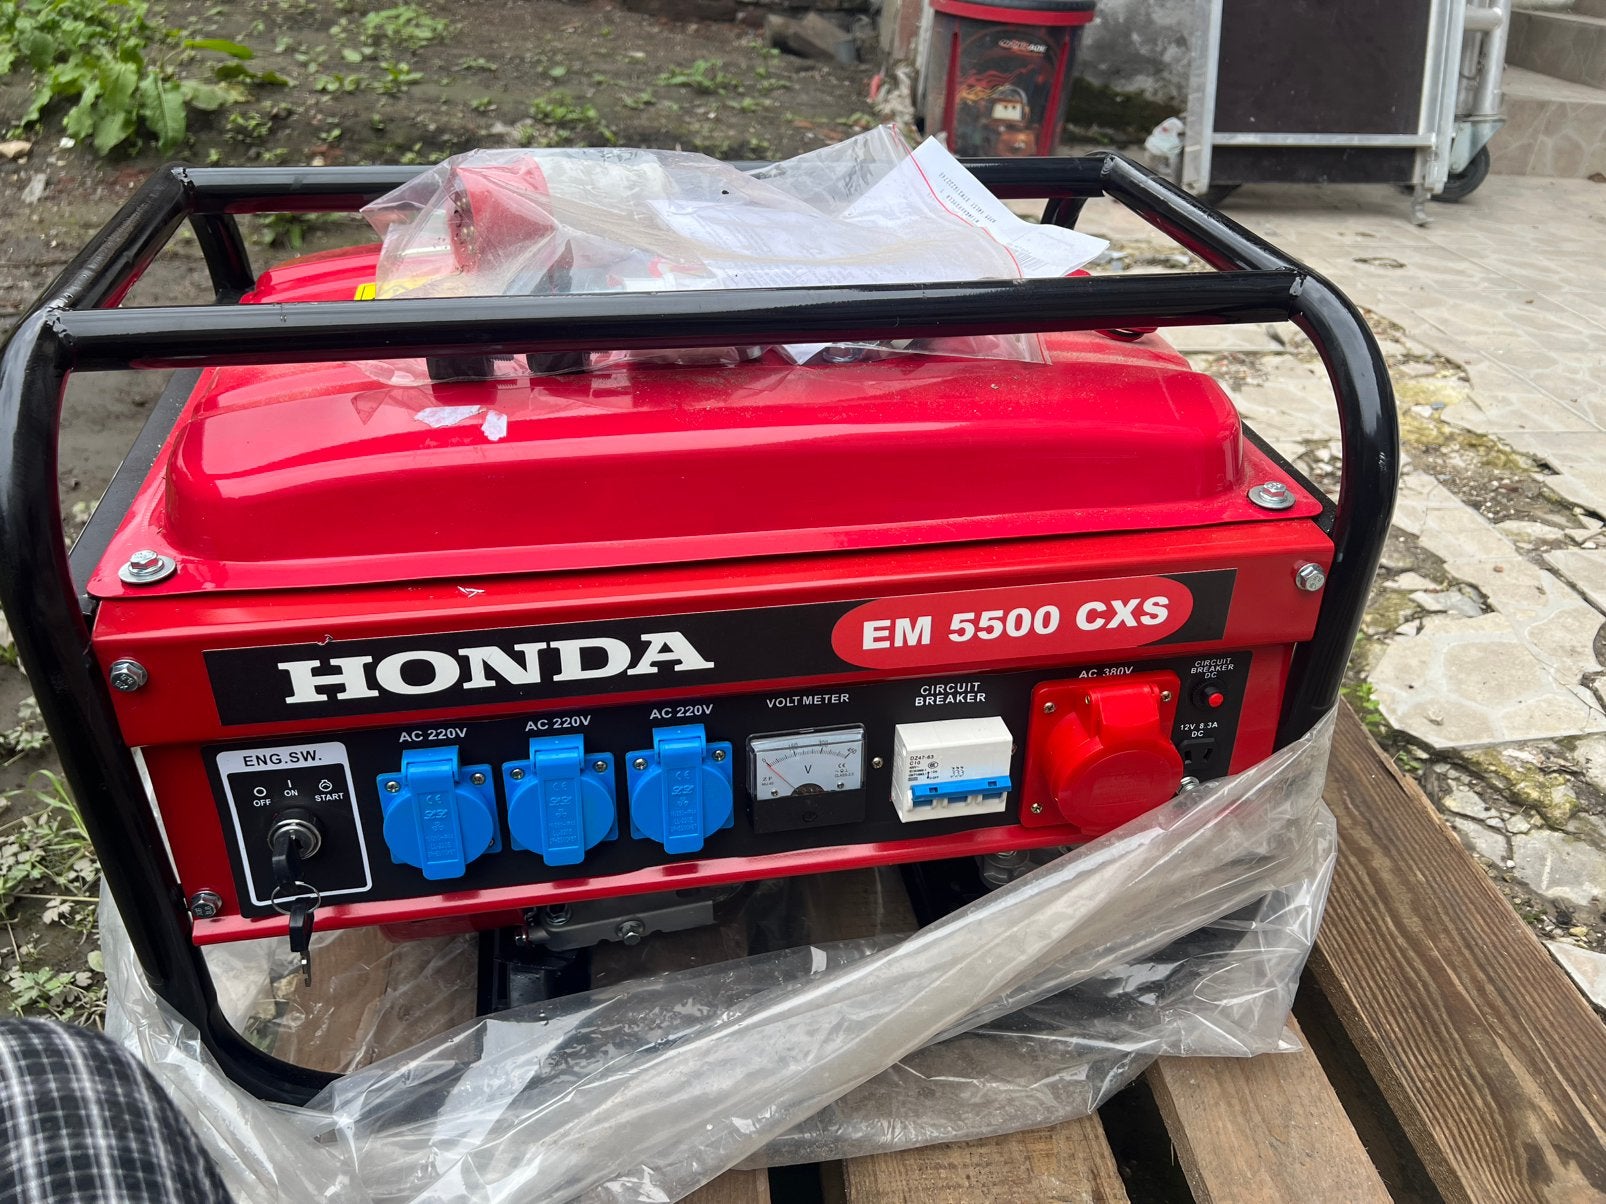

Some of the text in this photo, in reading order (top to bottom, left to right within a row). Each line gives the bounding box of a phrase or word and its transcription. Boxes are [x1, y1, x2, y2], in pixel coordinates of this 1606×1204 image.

[862, 596, 1170, 650] EM 5500 CXS
[277, 631, 715, 704] HONDA
[1195, 657, 1232, 667] CIRCUIT
[1078, 666, 1134, 678] AC 380V
[1190, 664, 1234, 674] BREAKER
[920, 682, 981, 695] CIRCUIT
[915, 693, 986, 707] BREAKER
[649, 704, 714, 720] AC 220V
[525, 715, 592, 732] AC 220V
[1180, 721, 1218, 731] 12V 8.3A
[399, 727, 467, 743] AC 220V
[1191, 730, 1204, 738] DC
[243, 749, 322, 767] ENG.SW.
[804, 764, 812, 774] V
[284, 789, 298, 797] ON
[314, 792, 344, 802] START
[253, 799, 272, 807] OFF
